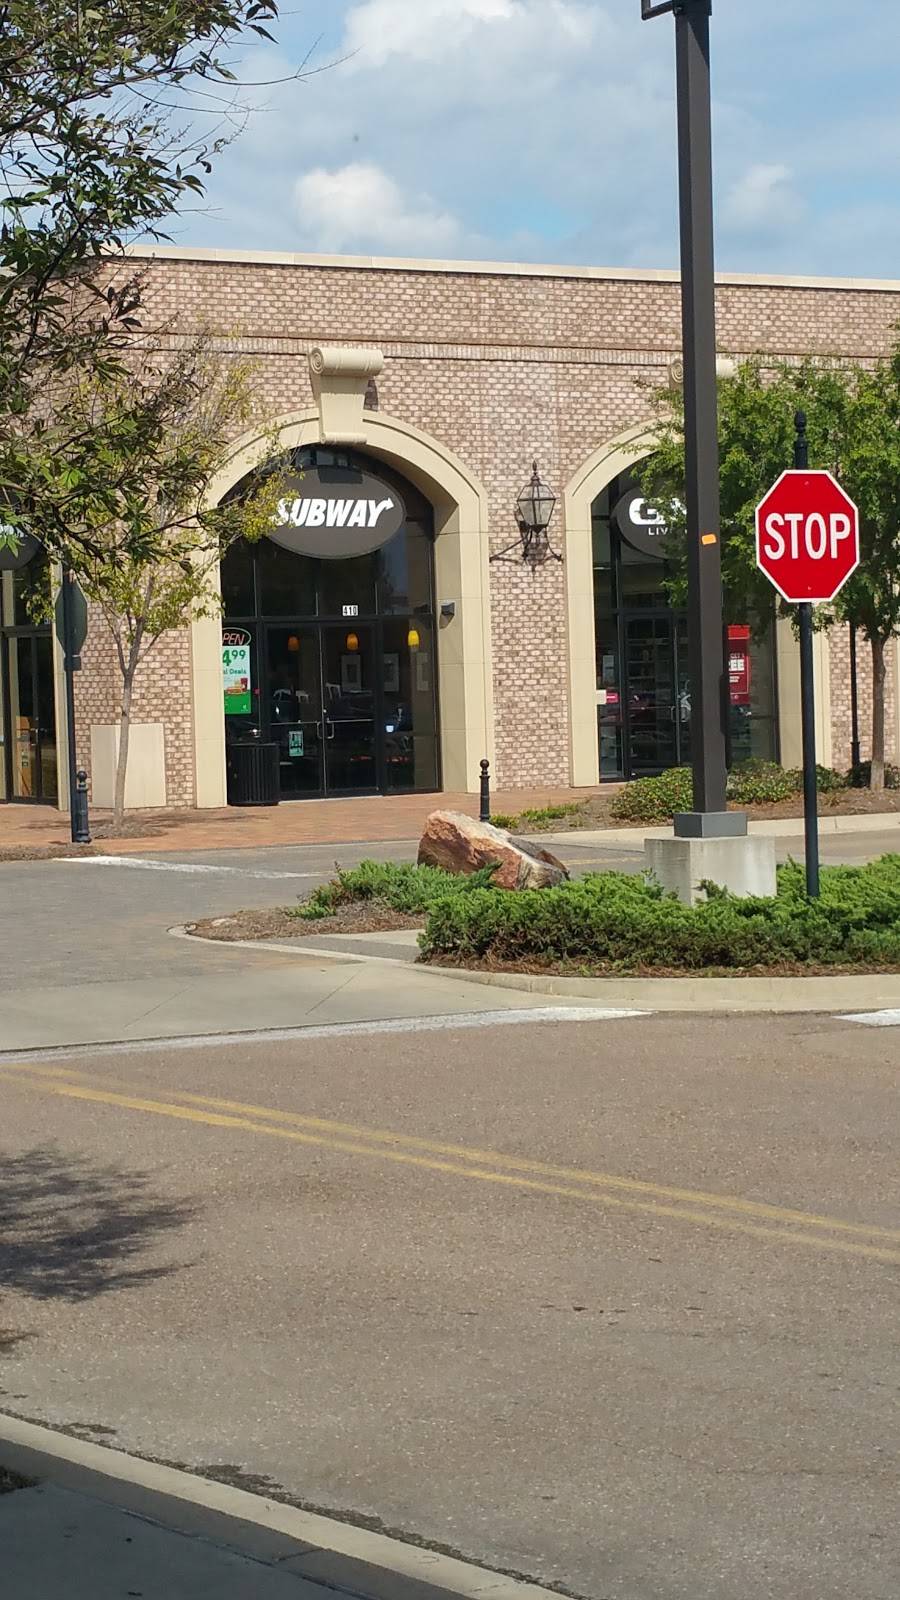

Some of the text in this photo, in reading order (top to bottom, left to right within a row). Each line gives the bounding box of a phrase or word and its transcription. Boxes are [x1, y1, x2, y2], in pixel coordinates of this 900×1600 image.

[274, 497, 394, 527] SUBWAY
[764, 512, 851, 560] STOP
[343, 606, 357, 615] 410
[223, 632, 245, 645] PEN
